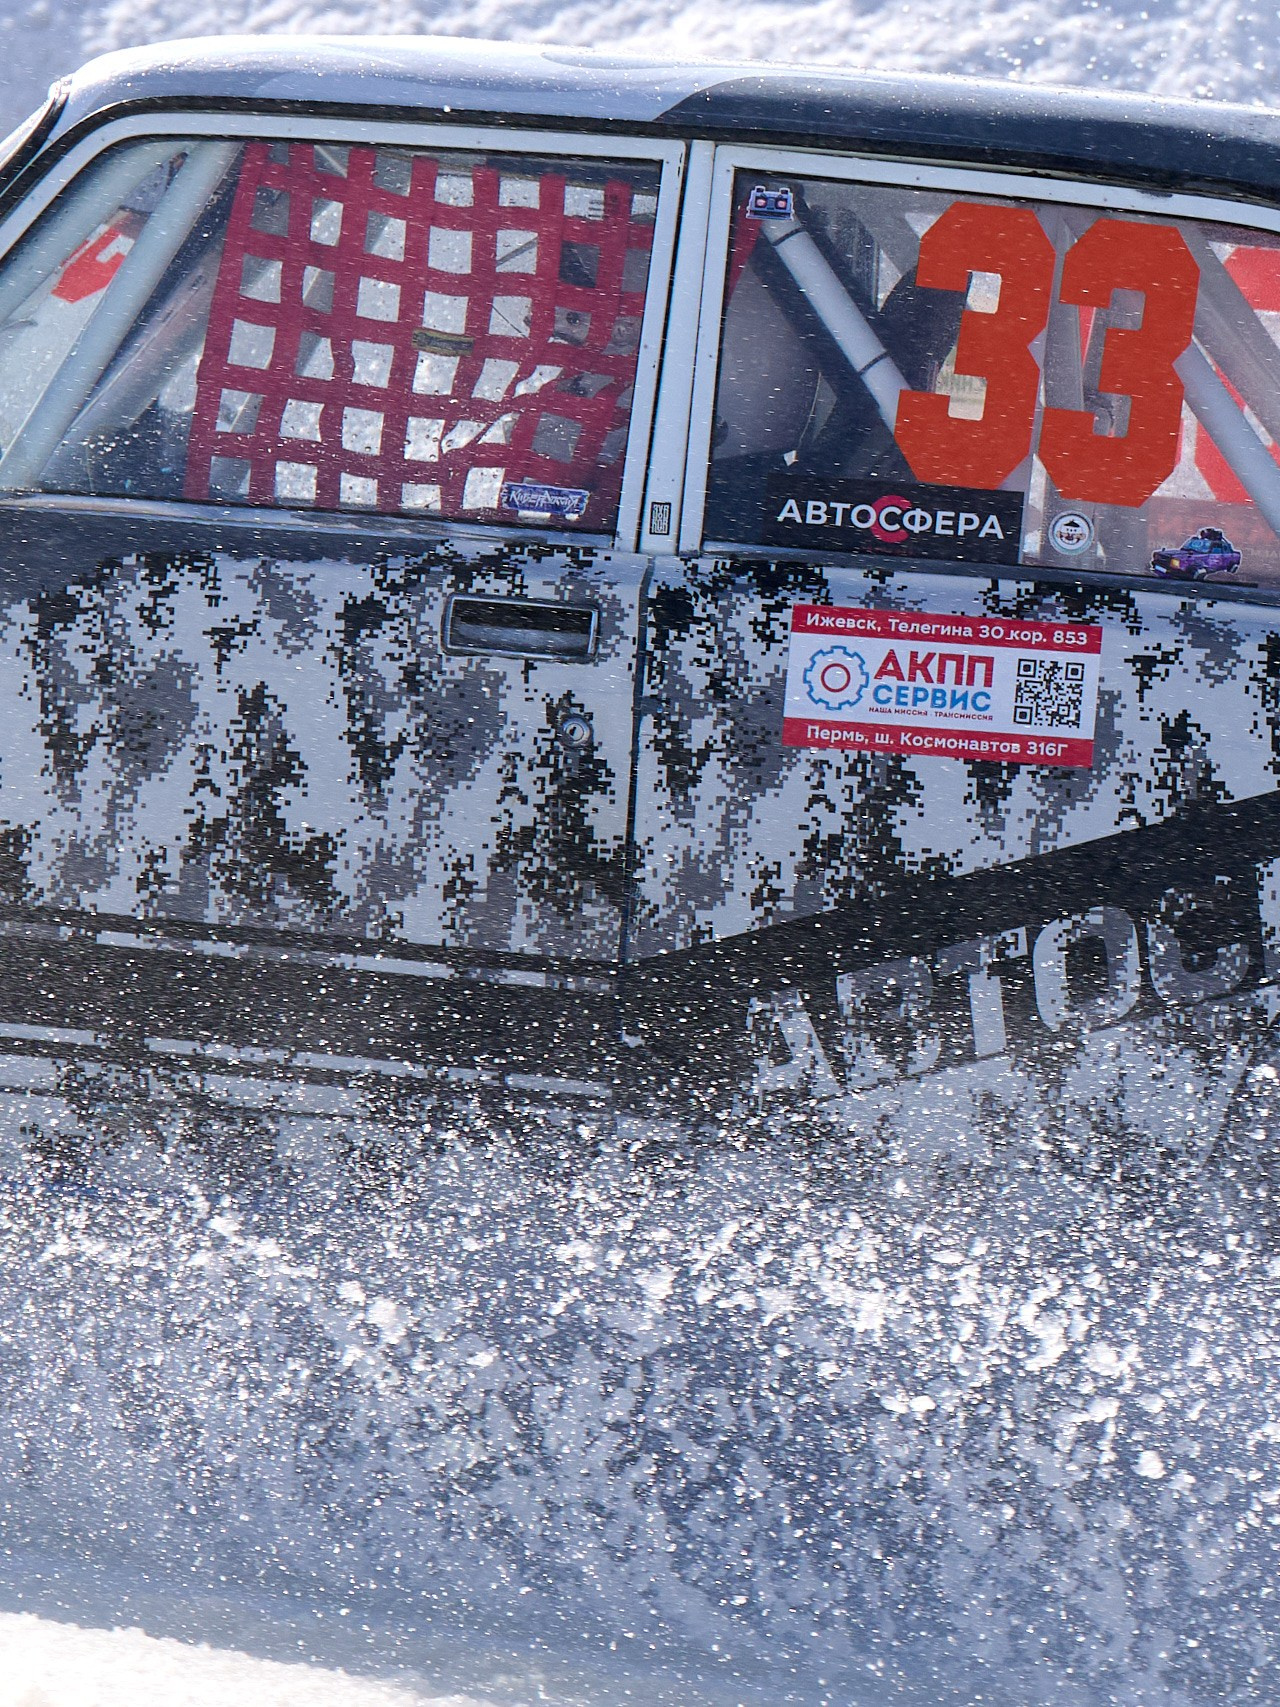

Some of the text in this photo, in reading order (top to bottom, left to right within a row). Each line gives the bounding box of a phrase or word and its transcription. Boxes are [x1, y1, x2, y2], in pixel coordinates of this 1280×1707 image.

[894, 201, 1200, 508] 33
[777, 498, 1004, 540] АВТОСФЕРА
[806, 613, 881, 632] Ижевск,
[889, 618, 973, 638] Телегина
[1009, 628, 1047, 645] кор.
[1053, 630, 1088, 645] 853
[873, 648, 995, 688] АКПП
[873, 684, 991, 712] СЕРВИС
[807, 725, 1068, 757] Пермь, ш. Космонавтов 316Г
